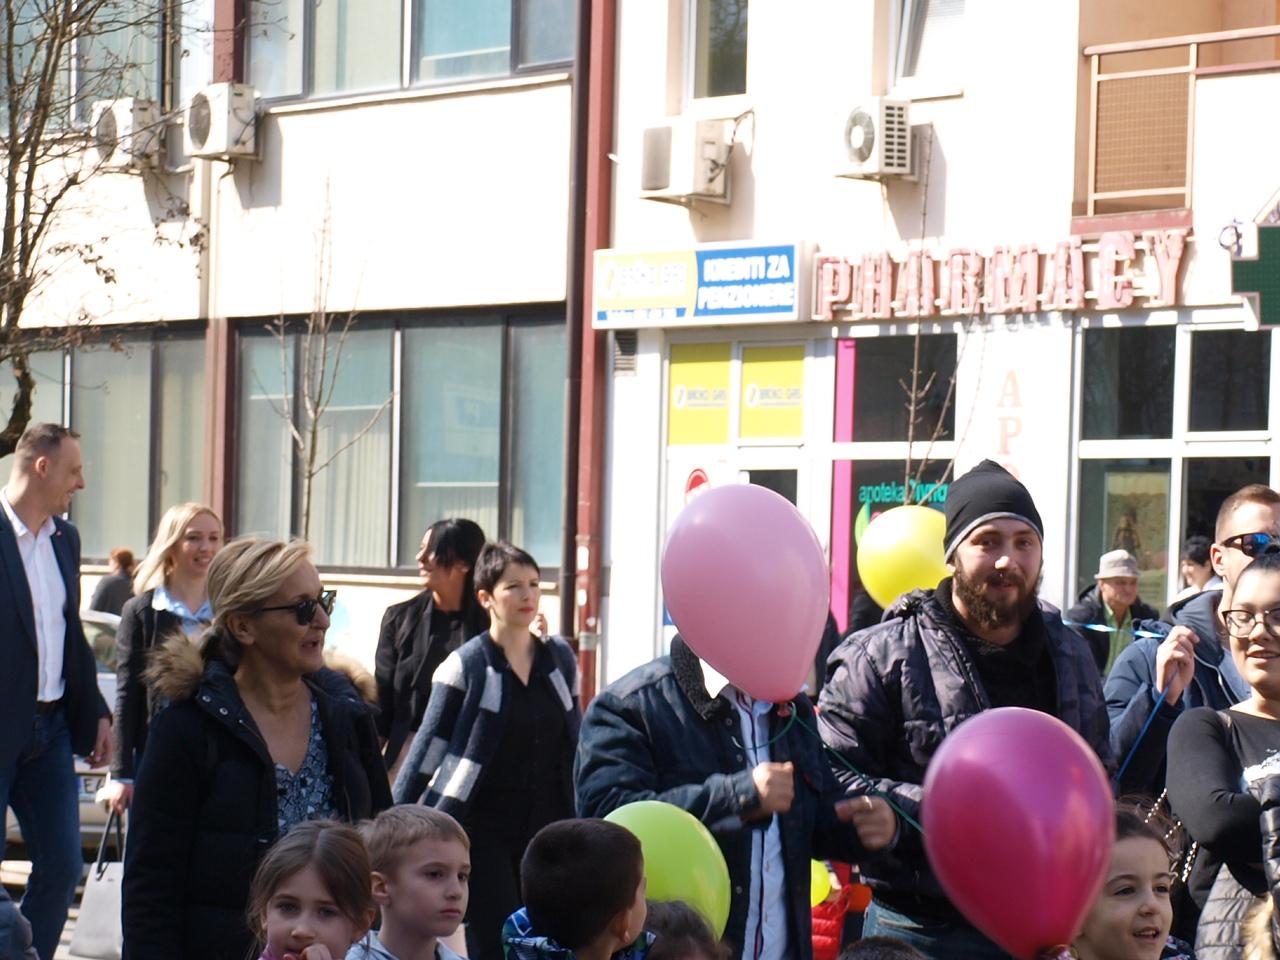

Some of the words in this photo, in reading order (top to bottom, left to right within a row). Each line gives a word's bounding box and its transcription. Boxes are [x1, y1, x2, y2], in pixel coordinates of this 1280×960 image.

[768, 255, 791, 279] ZA
[813, 231, 1191, 320] PHARMACY
[858, 481, 905, 503] apoteka
